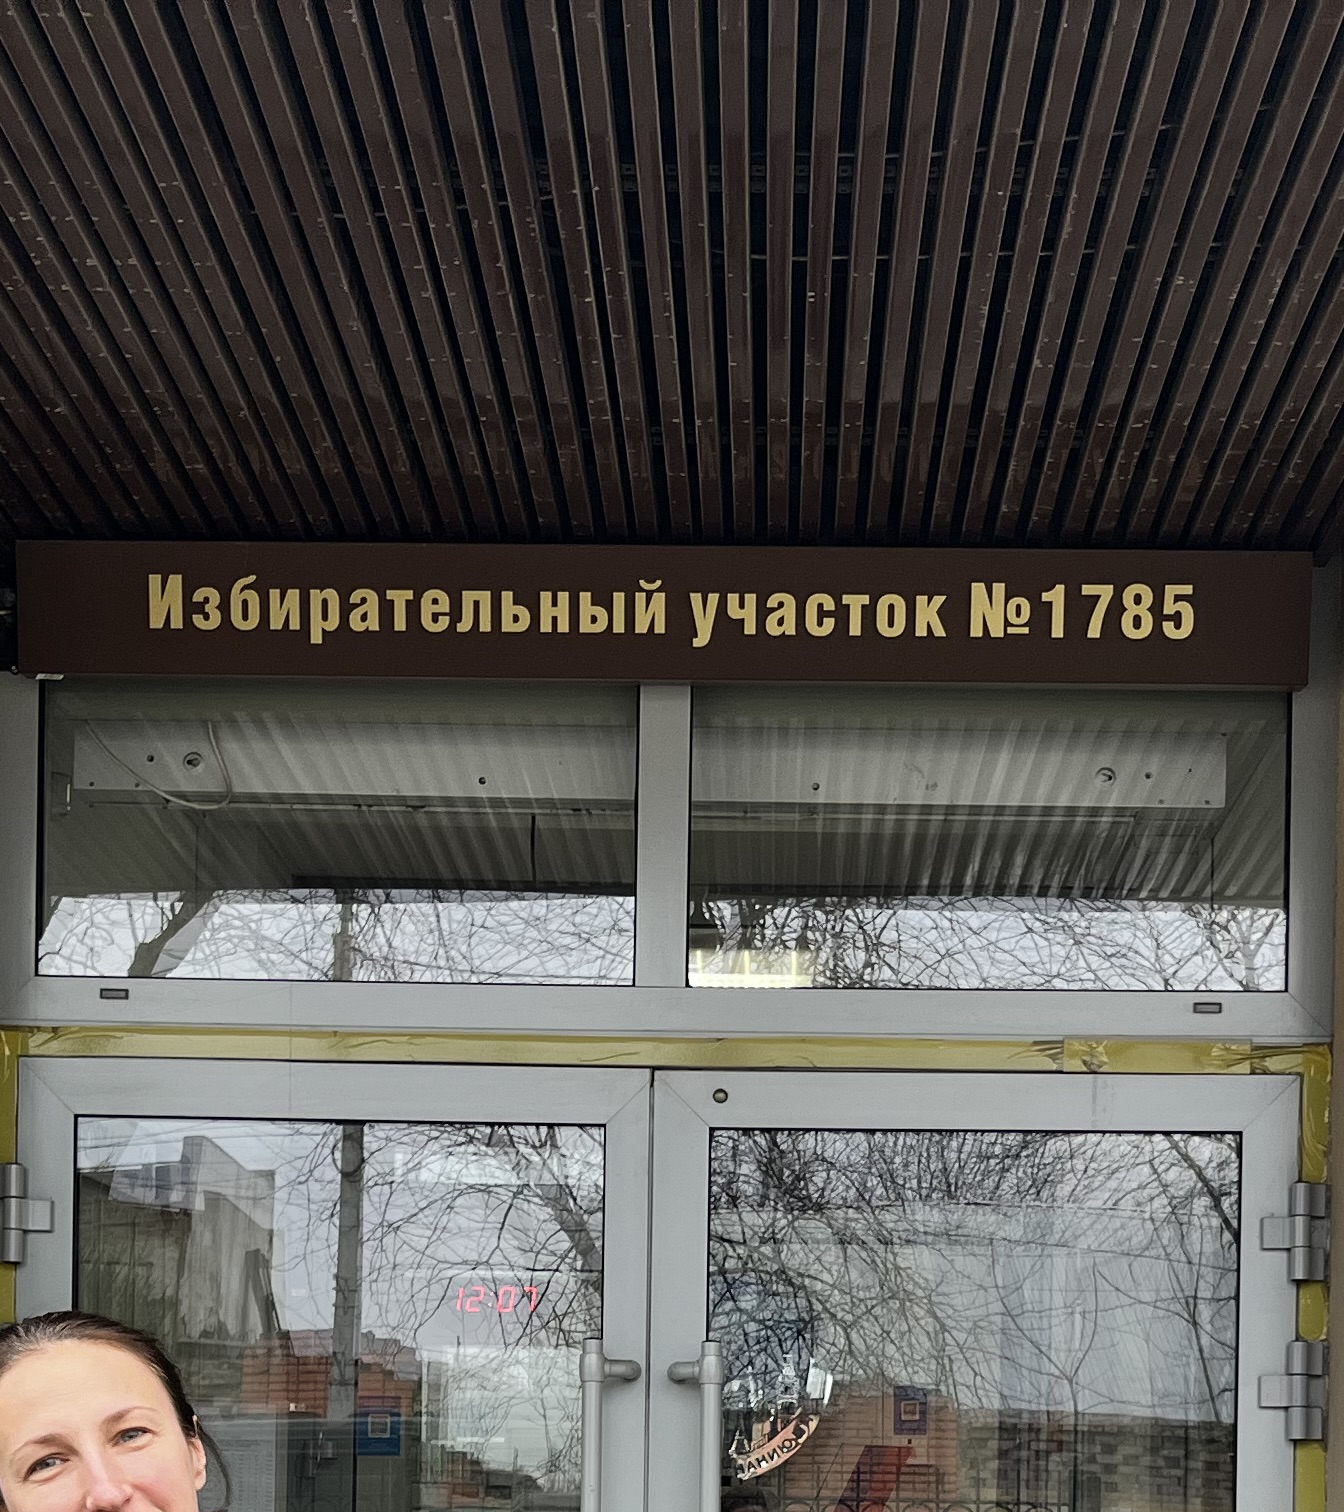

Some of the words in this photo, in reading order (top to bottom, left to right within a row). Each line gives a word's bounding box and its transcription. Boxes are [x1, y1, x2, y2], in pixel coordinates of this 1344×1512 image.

[147, 573, 667, 646] Избирательный
[690, 585, 948, 647] участок
[969, 581, 1197, 641] №1785
[456, 1285, 539, 1313] 12:07
